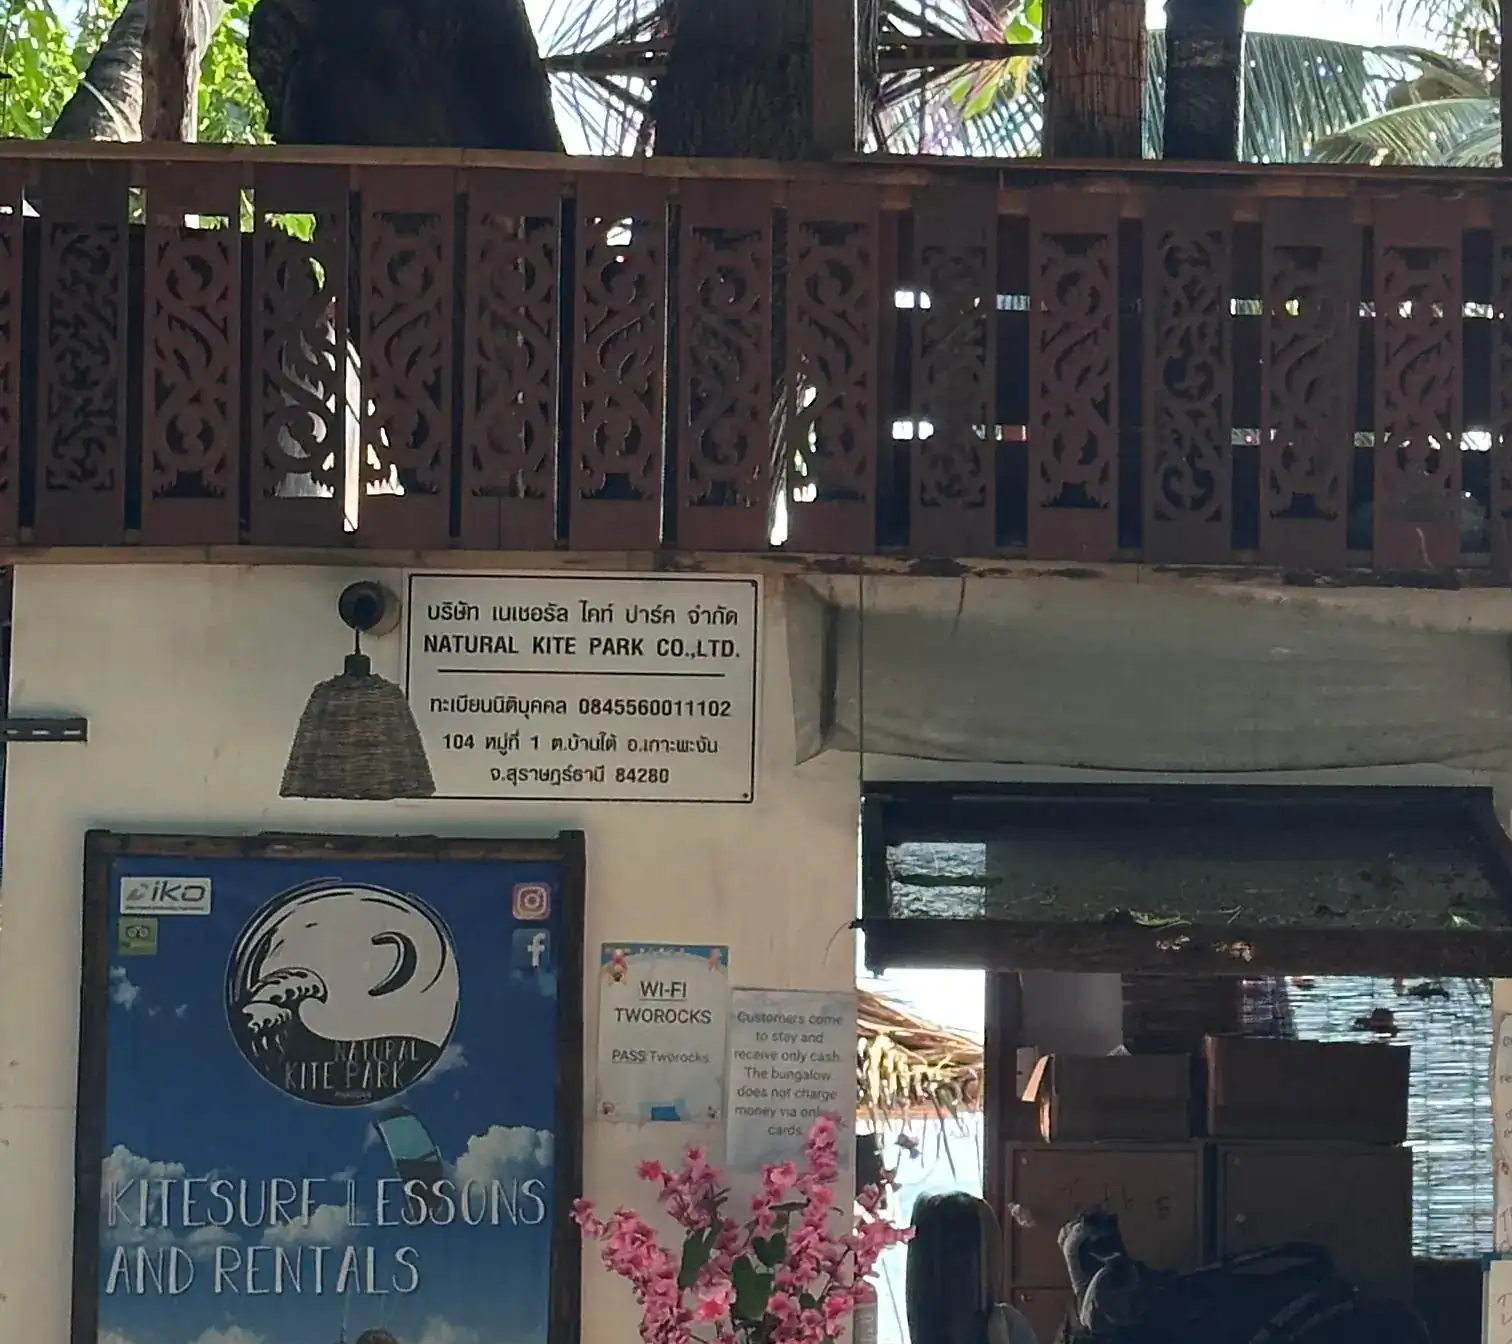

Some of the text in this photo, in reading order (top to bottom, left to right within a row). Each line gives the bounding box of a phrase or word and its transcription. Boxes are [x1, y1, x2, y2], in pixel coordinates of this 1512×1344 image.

[428, 600, 479, 621] บริษัท
[578, 599, 614, 624] ไคท์
[625, 604, 676, 625] ปาร์ค
[687, 604, 739, 626] จำกัด
[424, 634, 741, 660] NATURAL KITE PARK CO.,LTD.
[430, 694, 732, 720] ทะเบียนนิติบุคคล 0845560011102
[443, 728, 719, 756] 104 หมู่ที่ 1 ต.บ้านใต้ อ.เกาะพะงัน
[615, 767, 670, 784] 84280
[639, 979, 688, 999] WI-FI
[614, 1007, 712, 1025] TWOROCKS
[736, 1010, 843, 1025] Customers come
[755, 1031, 824, 1044] to stay and
[334, 1040, 419, 1062] NATURAL
[611, 1048, 710, 1064] PASS Tworocks
[733, 1049, 778, 1061] receive
[780, 1050, 808, 1064] only
[285, 1060, 405, 1090] KITE PARK
[743, 1066, 832, 1083] The bungalow
[736, 1085, 838, 1103] does not charge
[734, 1105, 777, 1118] money
[780, 1106, 797, 1117] via
[107, 1176, 547, 1228] KITESURF LESSONS
[105, 1245, 421, 1295] AND RENTALS
